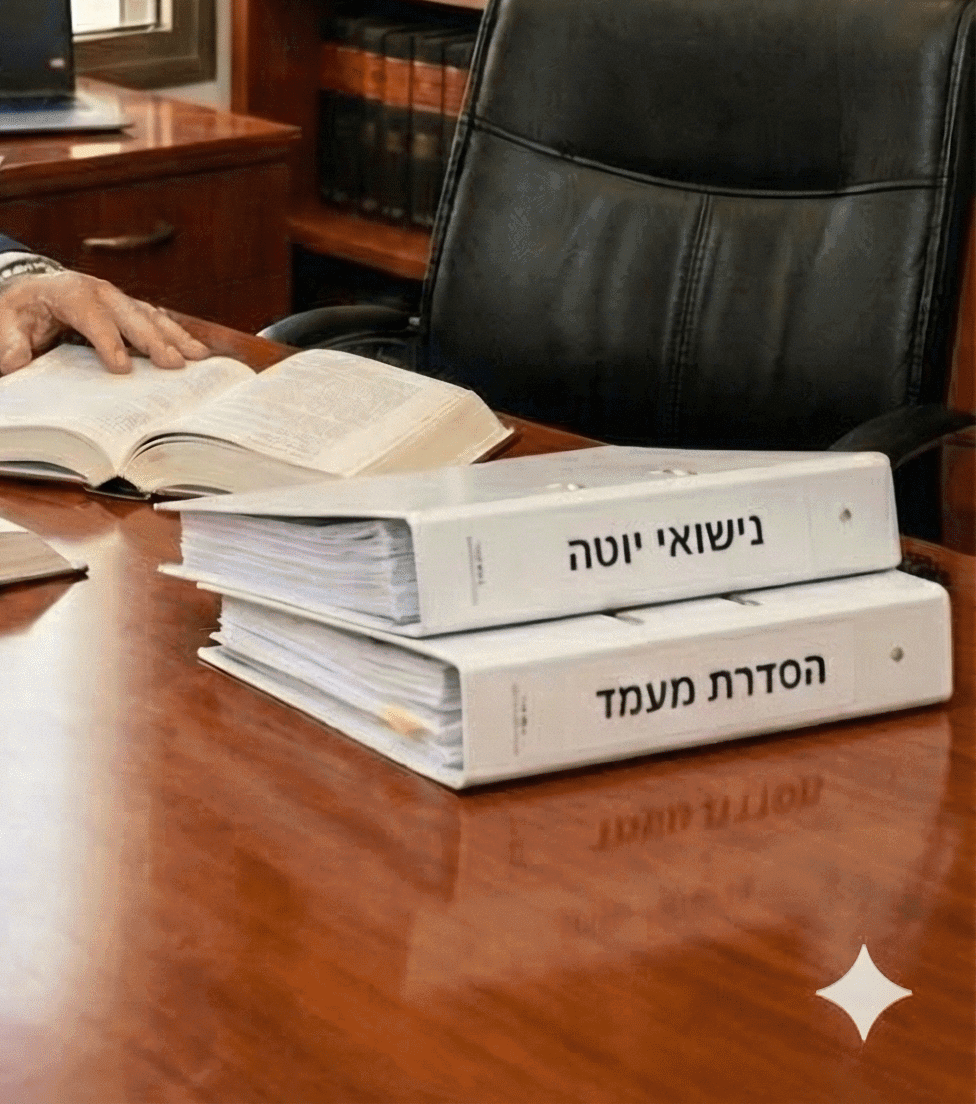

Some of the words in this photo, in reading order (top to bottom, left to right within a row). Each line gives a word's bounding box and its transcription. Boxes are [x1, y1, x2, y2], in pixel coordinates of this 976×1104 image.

[567, 531, 642, 571] יוטה
[657, 514, 765, 558] נישואי
[595, 675, 696, 720] מעמד
[707, 654, 826, 702] הסדרת
